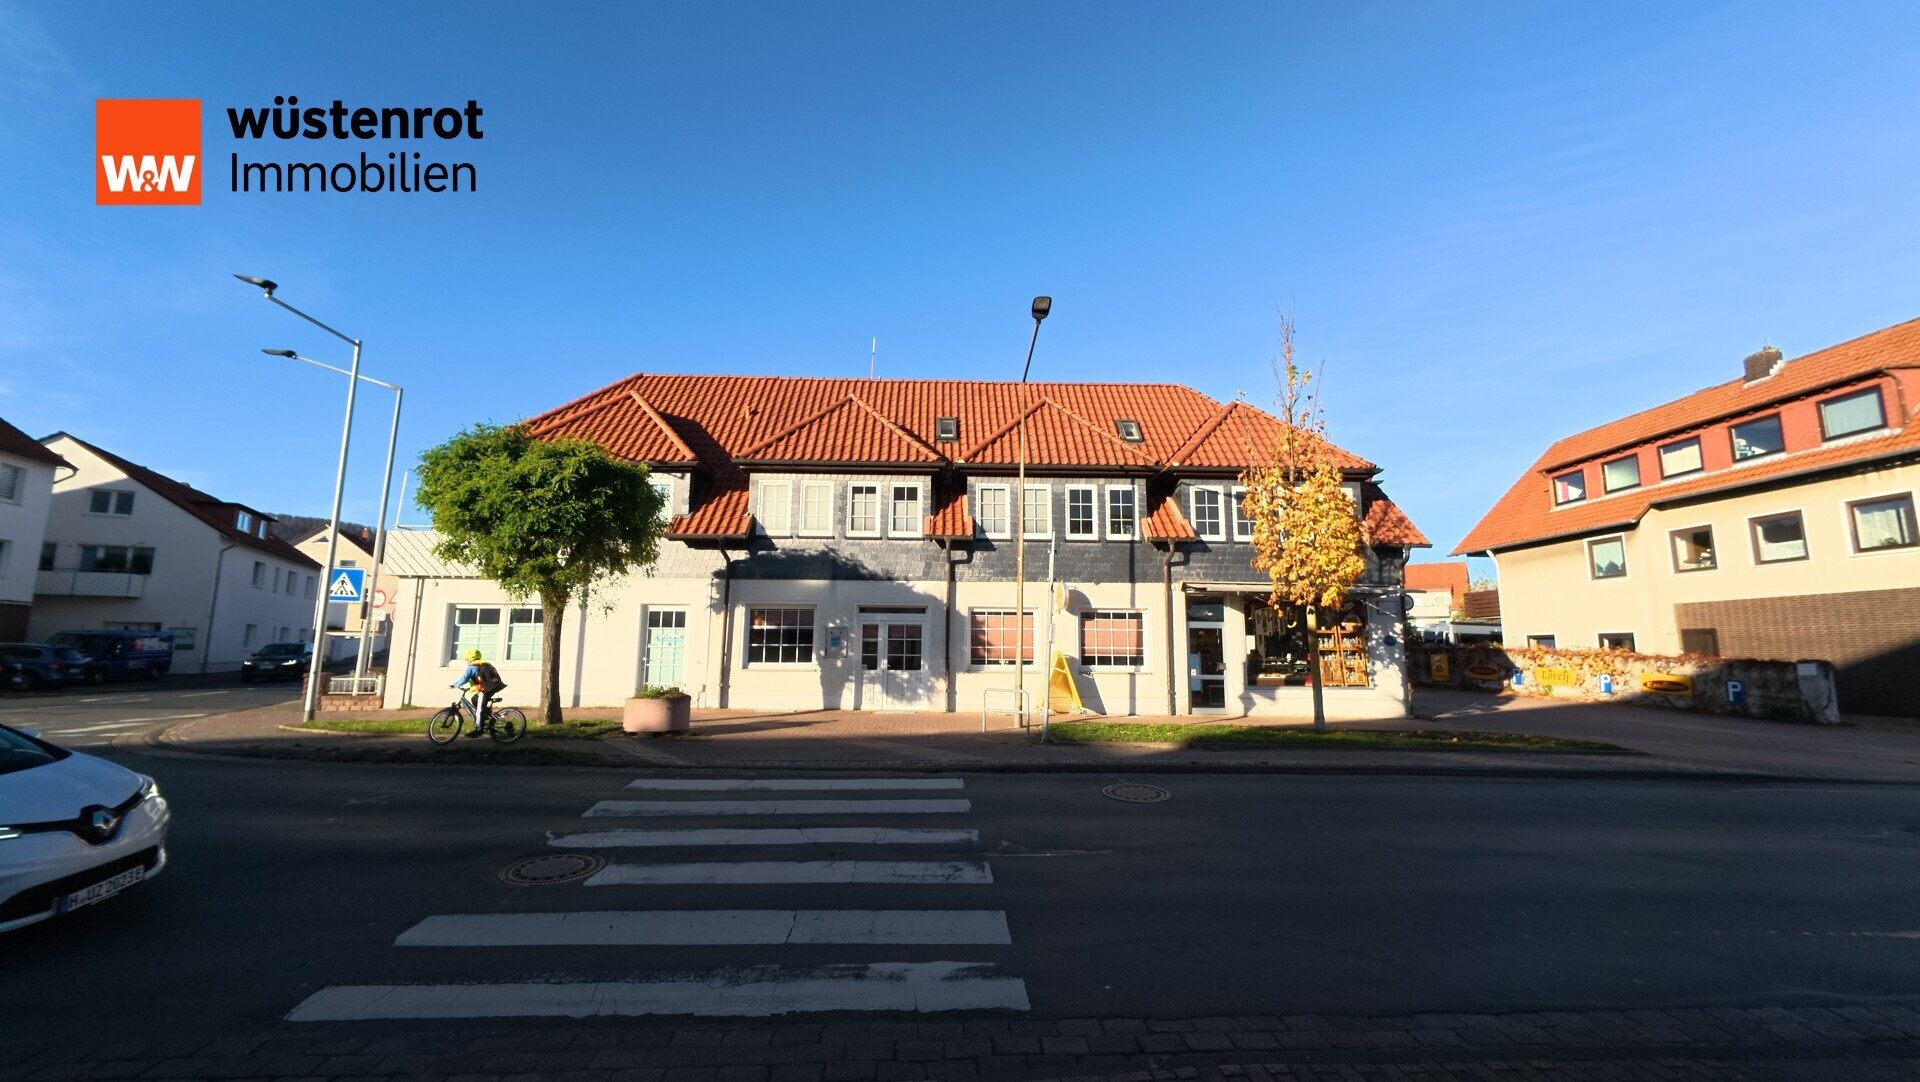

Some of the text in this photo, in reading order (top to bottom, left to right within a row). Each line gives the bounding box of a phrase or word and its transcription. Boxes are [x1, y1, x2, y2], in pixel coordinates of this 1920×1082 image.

[1600, 674, 1611, 692] P
[1728, 681, 1741, 701] P
[69, 894, 79, 908] H
